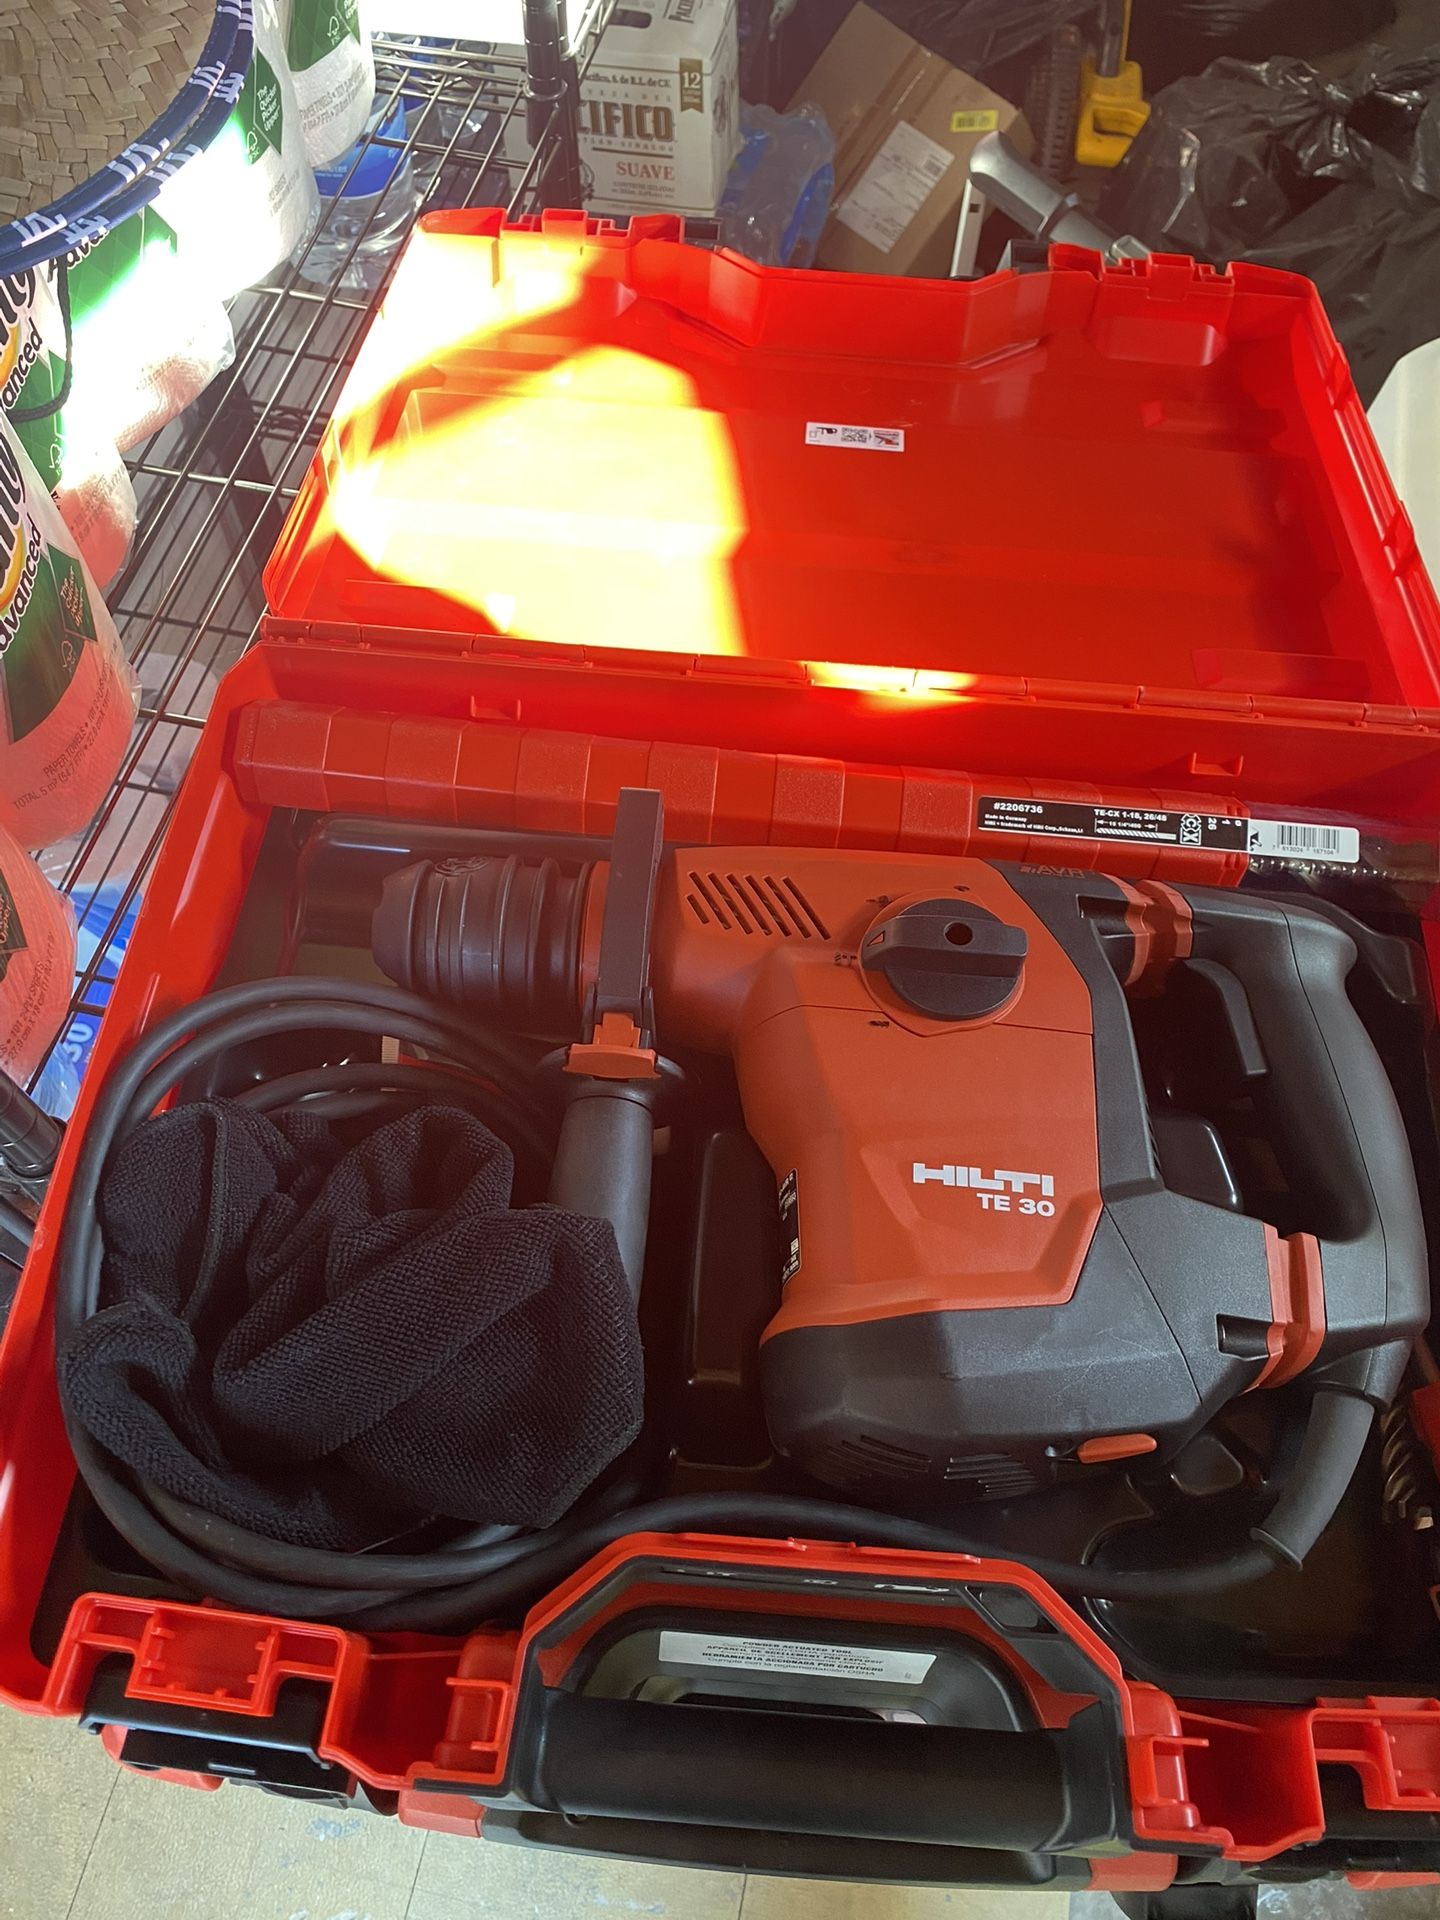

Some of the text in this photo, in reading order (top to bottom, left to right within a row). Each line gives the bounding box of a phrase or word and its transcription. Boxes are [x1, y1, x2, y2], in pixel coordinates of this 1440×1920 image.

[682, 71, 701, 89] 12
[616, 160, 676, 181] SUAVE
[43, 754, 68, 778] PAPER
[65, 726, 87, 758] TOWELS
[13, 791, 41, 810] TOTAL
[40, 785, 48, 796] 5
[993, 802, 1043, 813] #2206736
[1093, 808, 1120, 818] TE-CX
[913, 1162, 1055, 1197] HILTI
[976, 1192, 1056, 1217] TE 30
[702, 1652, 763, 1661] HERRAMIENTA
[765, 1657, 815, 1666] ACCIONADA
[837, 1663, 884, 1672] CARTUCHO
